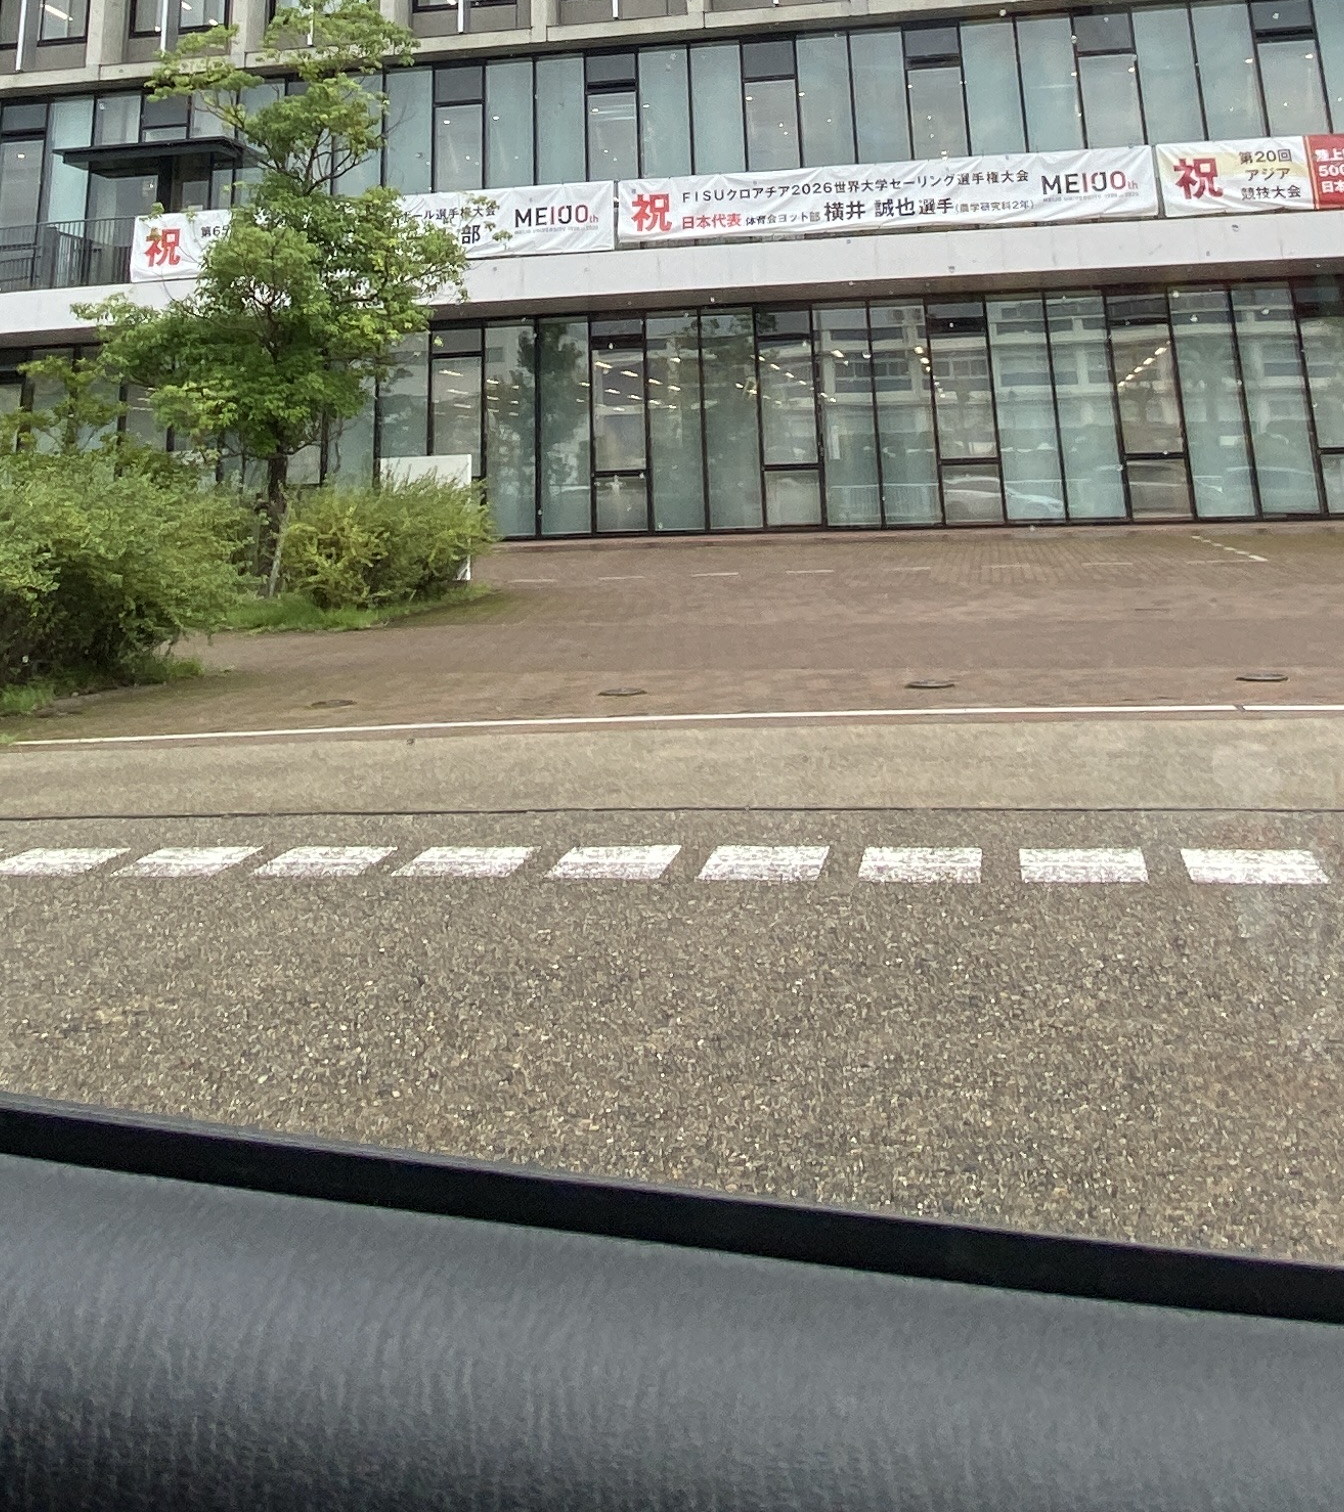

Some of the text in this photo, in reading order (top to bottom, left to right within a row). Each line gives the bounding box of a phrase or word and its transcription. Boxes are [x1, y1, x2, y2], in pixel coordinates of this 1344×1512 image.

[1238, 148, 1293, 165] 第20回
[1173, 157, 1224, 199] 祝
[1245, 167, 1291, 182] アジア
[1241, 184, 1301, 201] 競技大会
[631, 193, 672, 232] 祝
[682, 213, 742, 230] 日本代表
[144, 227, 181, 267] 祝
